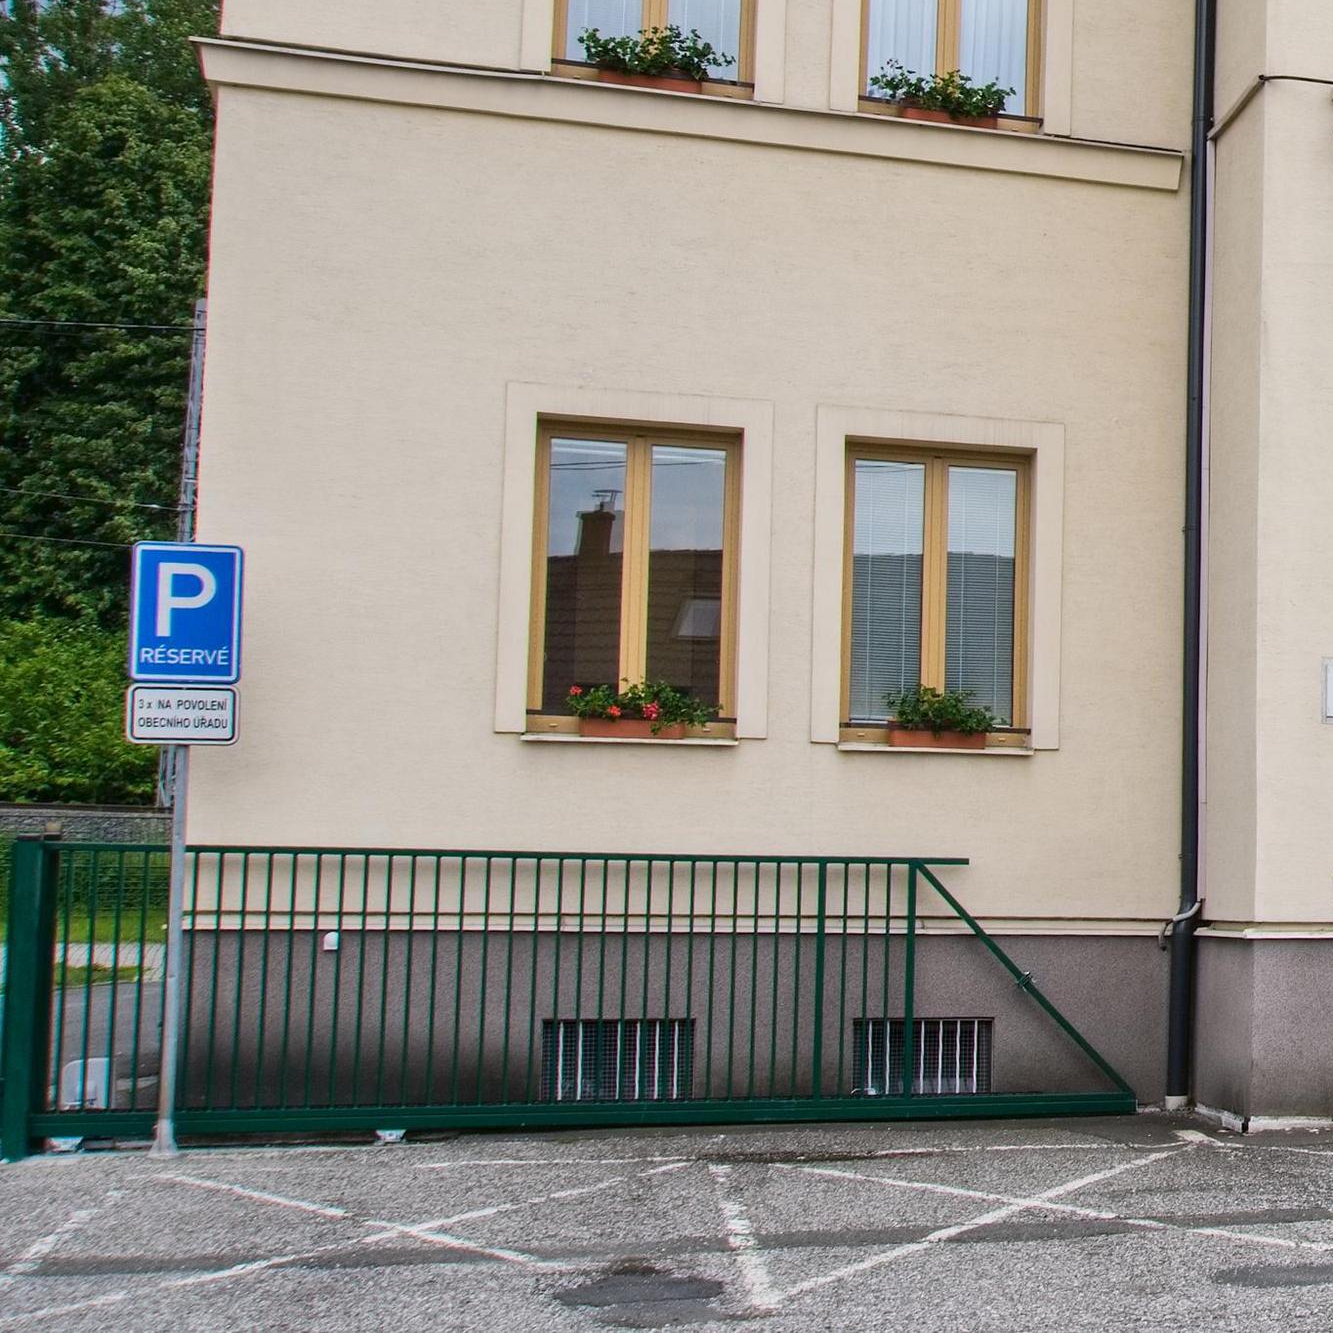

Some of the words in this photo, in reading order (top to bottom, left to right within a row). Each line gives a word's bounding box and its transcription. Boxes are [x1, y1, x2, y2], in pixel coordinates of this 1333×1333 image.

[156, 562, 217, 637] P
[139, 644, 229, 665] RÉSERVÉ
[158, 699, 172, 710] NA
[176, 698, 228, 711] POVOLENÍ
[138, 715, 190, 729] OBECNÍHO
[193, 715, 228, 730] ÚŘADU
